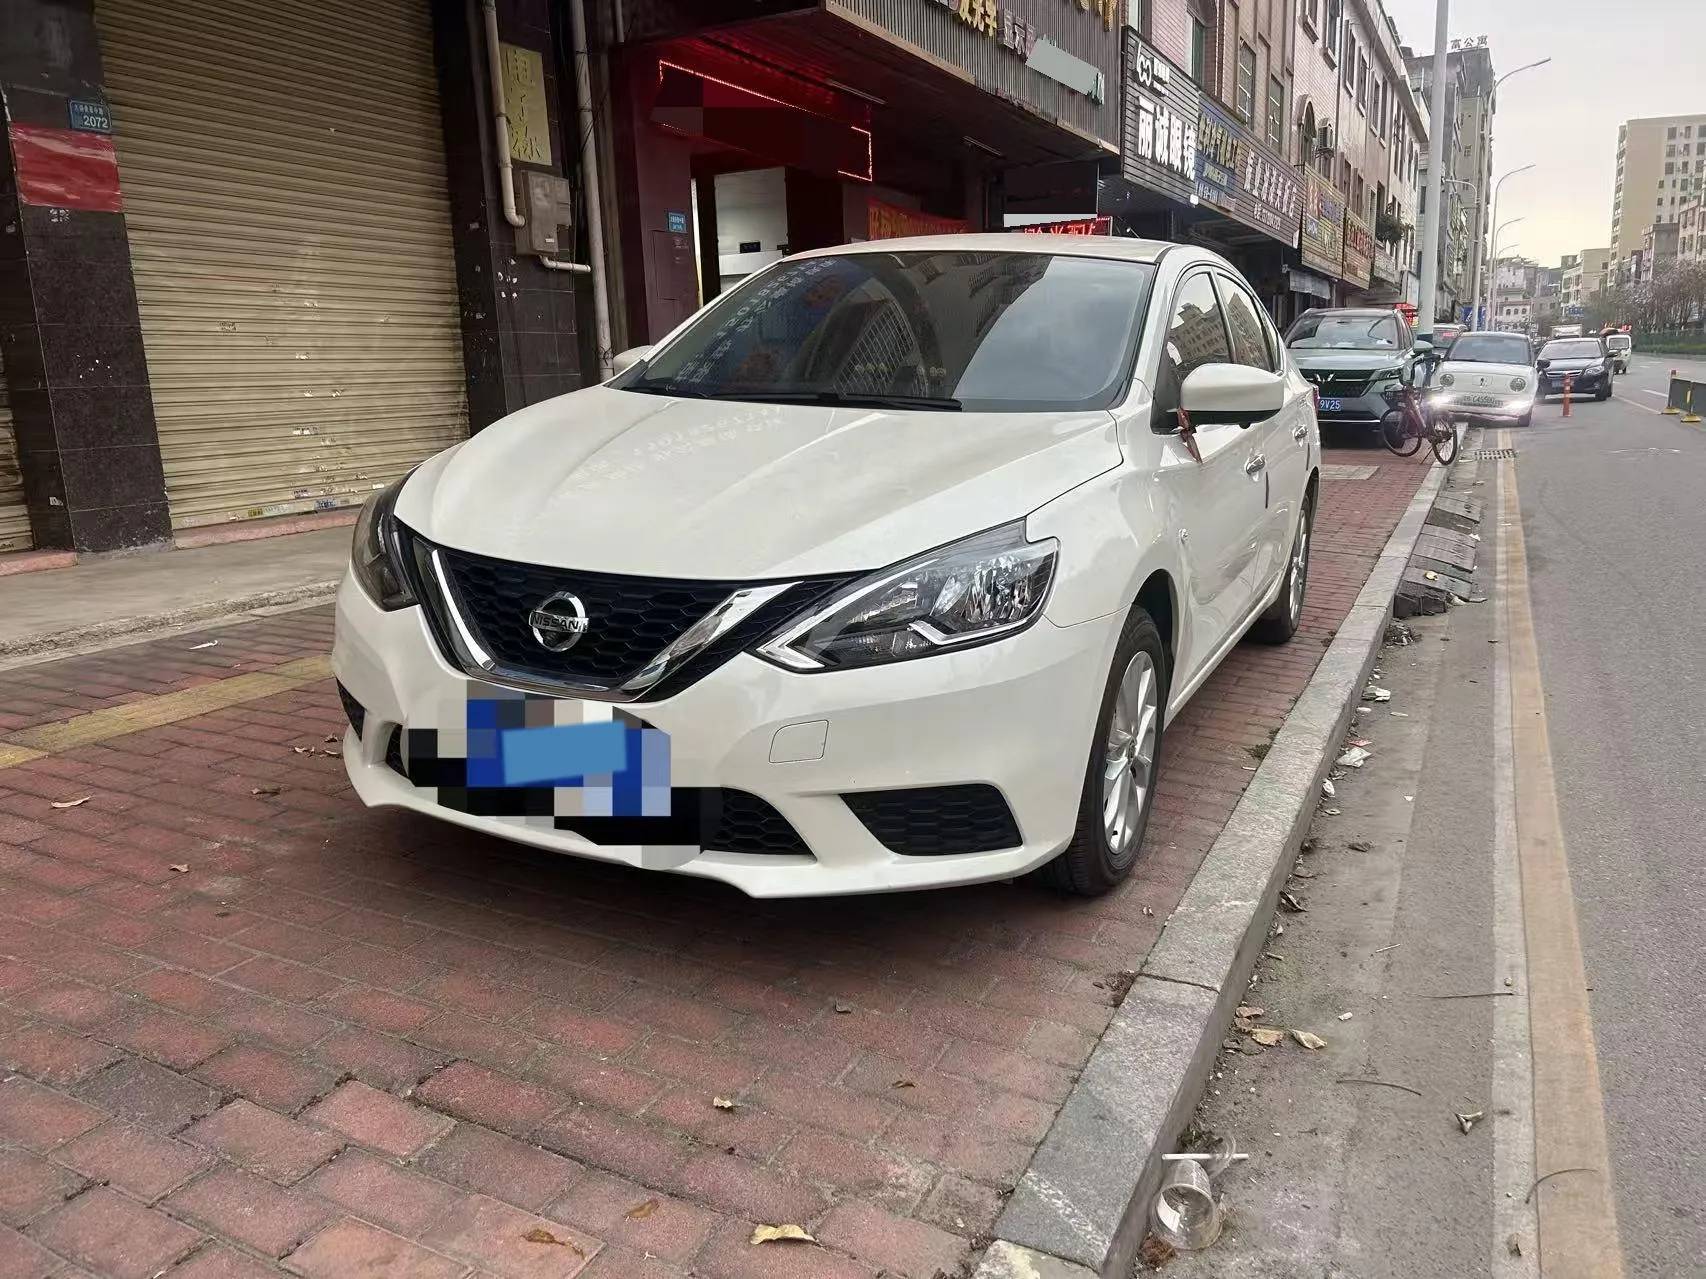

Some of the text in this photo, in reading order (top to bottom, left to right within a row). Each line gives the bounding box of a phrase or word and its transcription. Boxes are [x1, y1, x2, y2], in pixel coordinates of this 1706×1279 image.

[83, 115, 108, 128] 2072
[1319, 400, 1341, 410] 9V25
[532, 613, 579, 630] NISSAN
